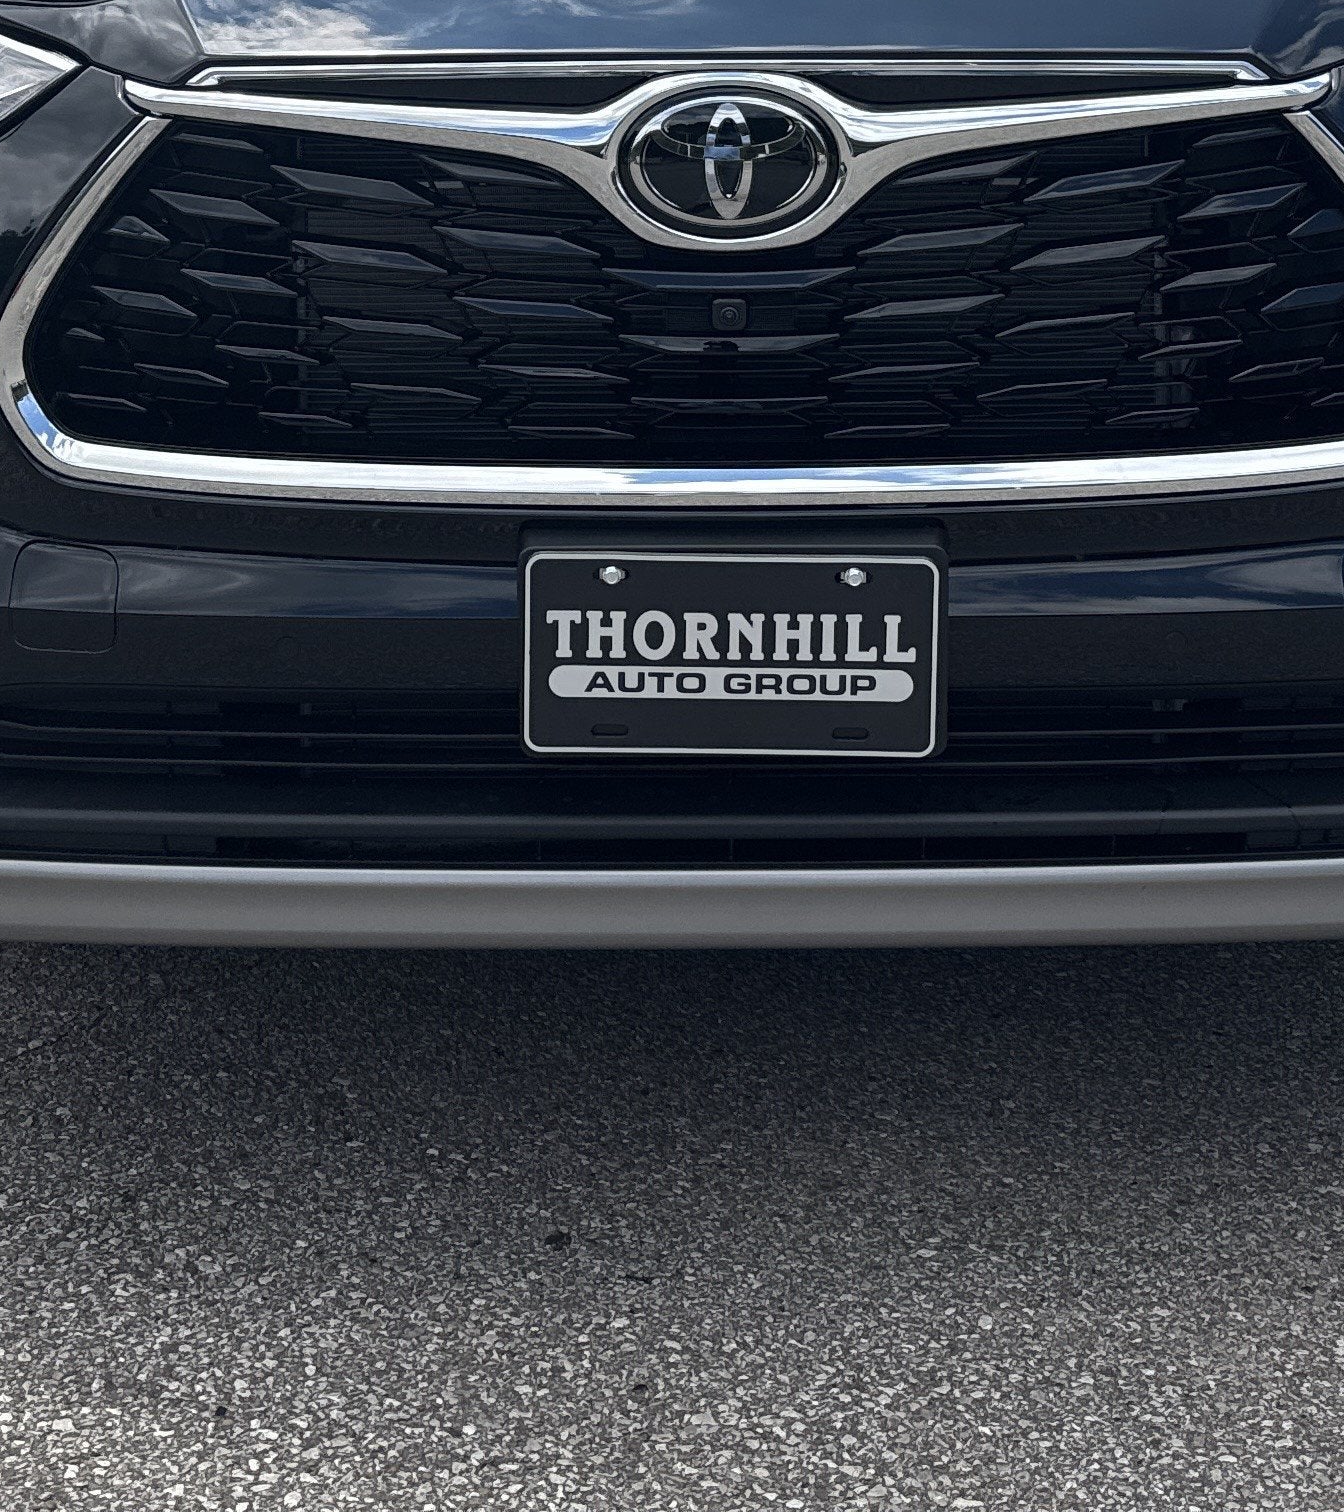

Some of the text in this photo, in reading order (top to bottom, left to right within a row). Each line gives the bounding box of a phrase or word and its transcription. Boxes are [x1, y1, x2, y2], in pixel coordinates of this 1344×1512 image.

[546, 609, 917, 663] THORNHILL
[584, 671, 877, 696] AUTO GROUP
